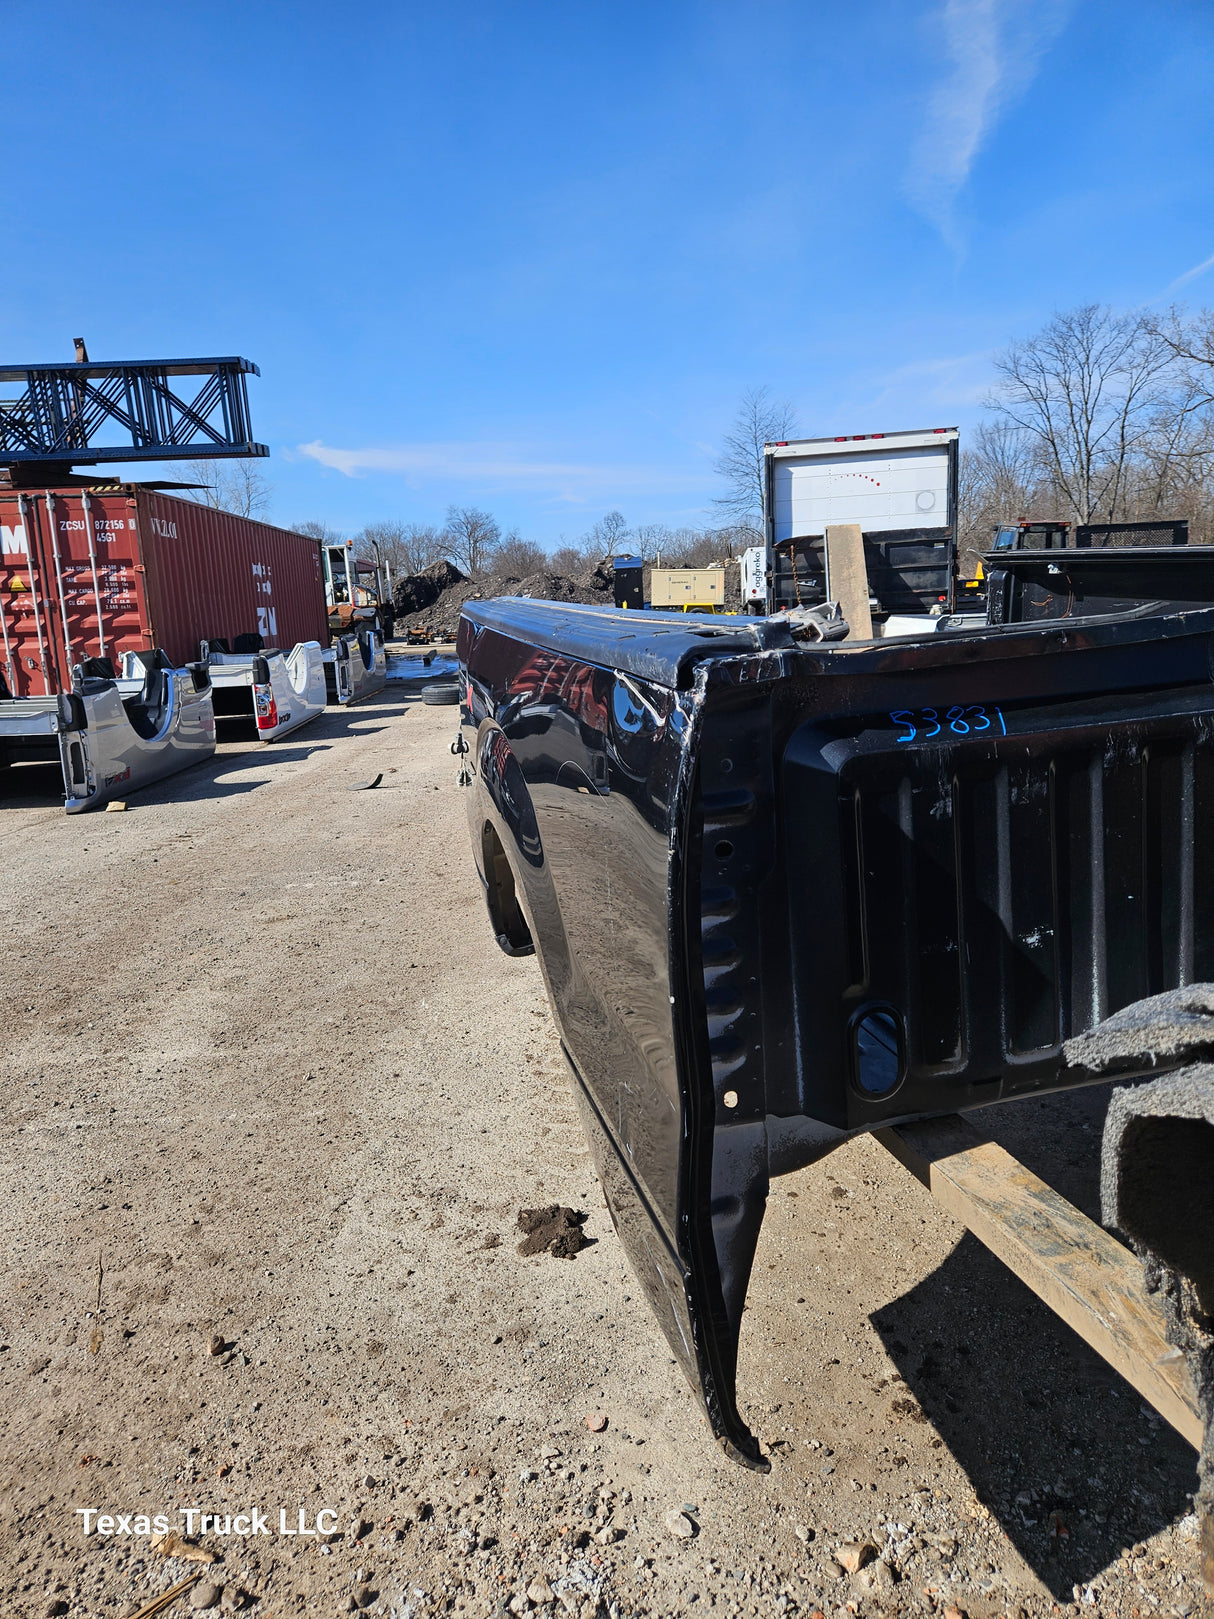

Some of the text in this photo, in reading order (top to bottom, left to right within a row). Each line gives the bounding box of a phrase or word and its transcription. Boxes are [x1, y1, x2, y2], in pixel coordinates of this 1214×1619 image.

[60, 520, 85, 531] ZCSU
[94, 519, 124, 530] 872156
[96, 532, 116, 542] 45G1
[752, 551, 763, 588] aggreko
[889, 705, 1007, 742] 53831
